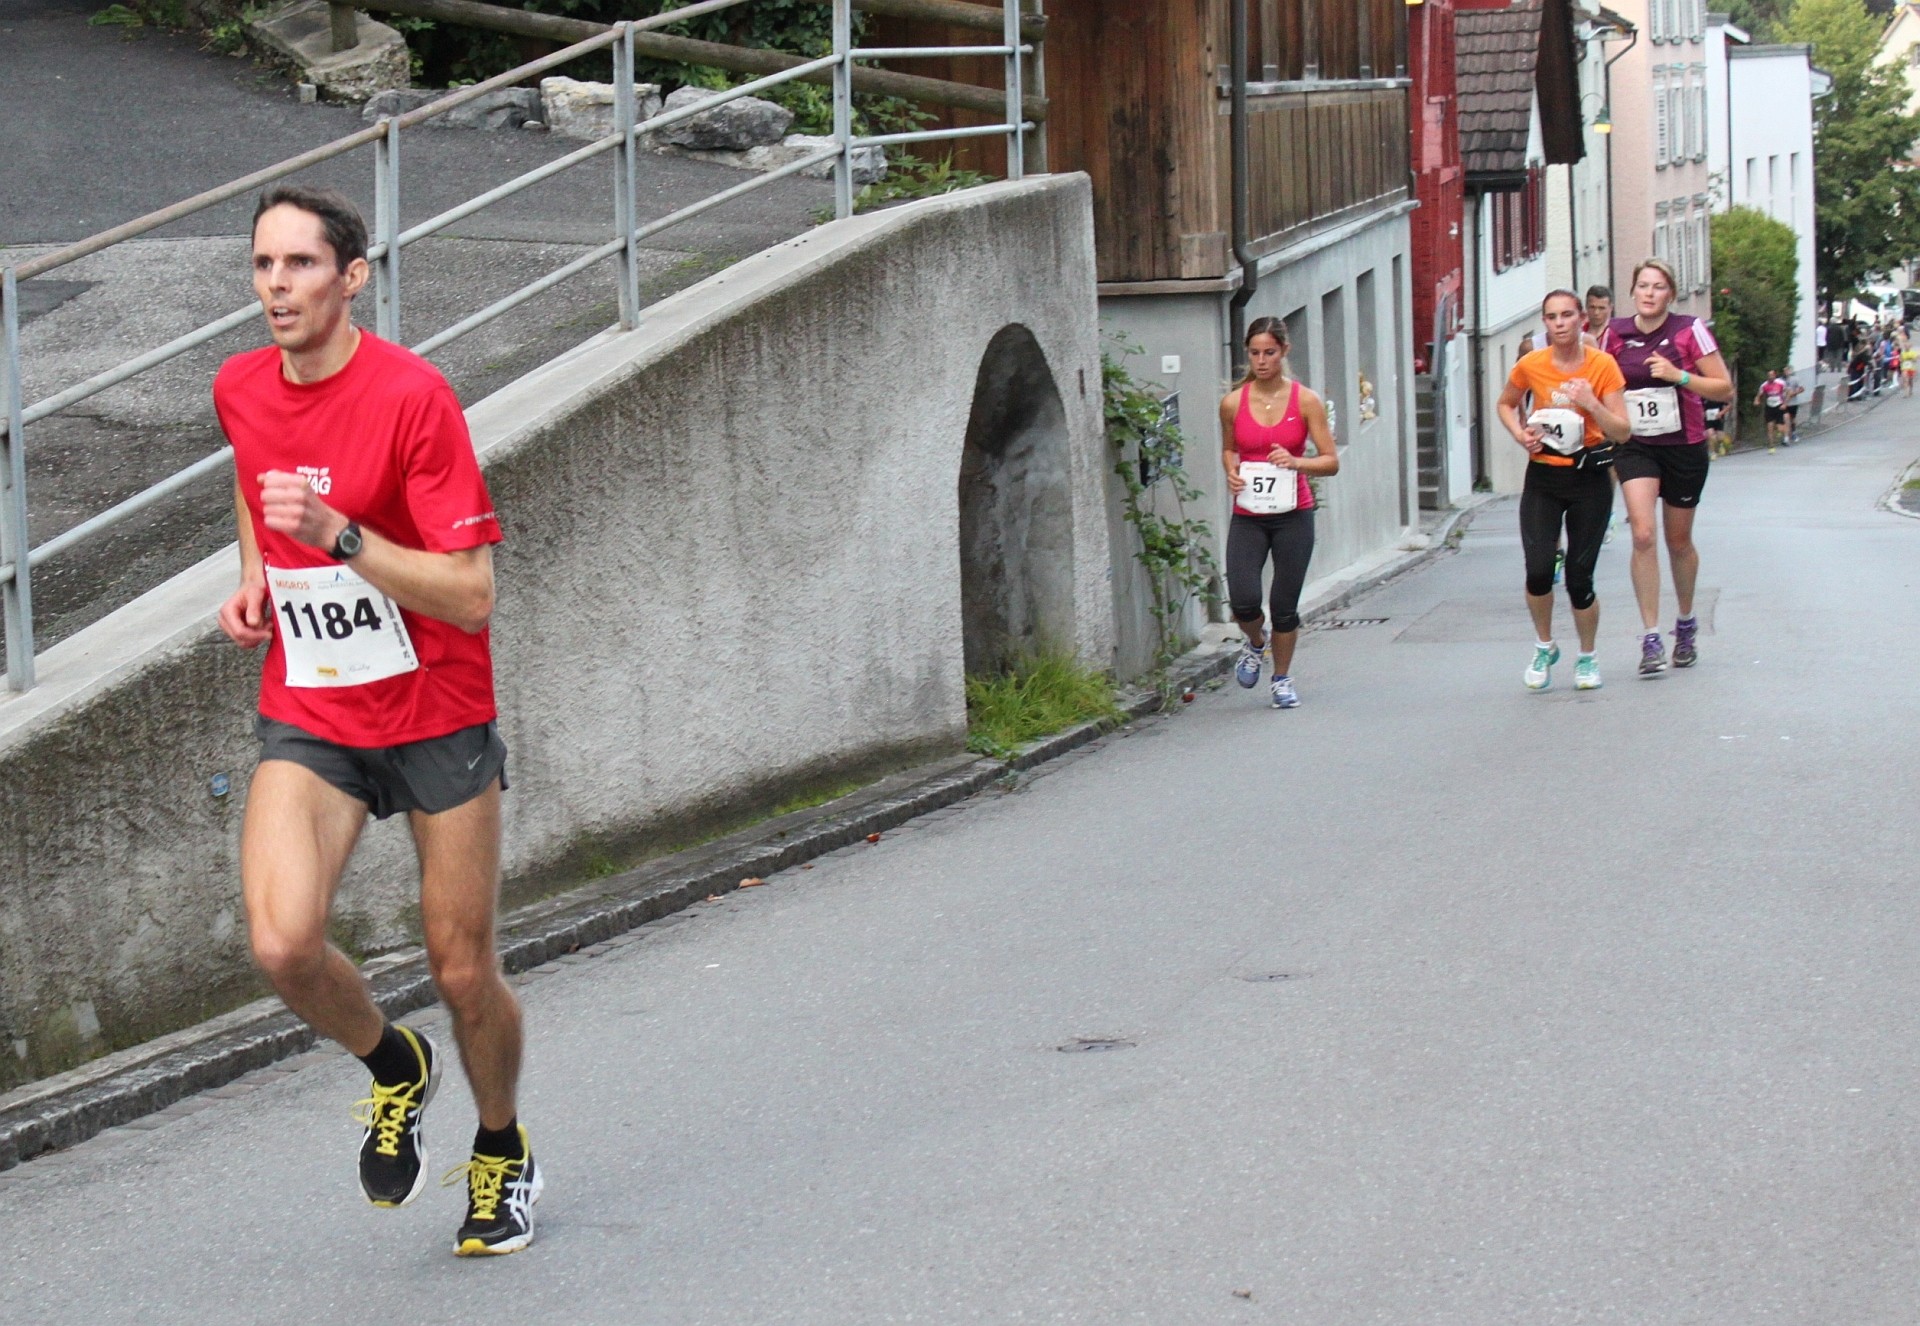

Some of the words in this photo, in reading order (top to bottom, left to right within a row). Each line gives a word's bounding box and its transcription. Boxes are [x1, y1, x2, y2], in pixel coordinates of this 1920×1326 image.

[1638, 401, 1659, 417] 18
[1253, 476, 1276, 493] 57
[280, 597, 382, 640] 1184
